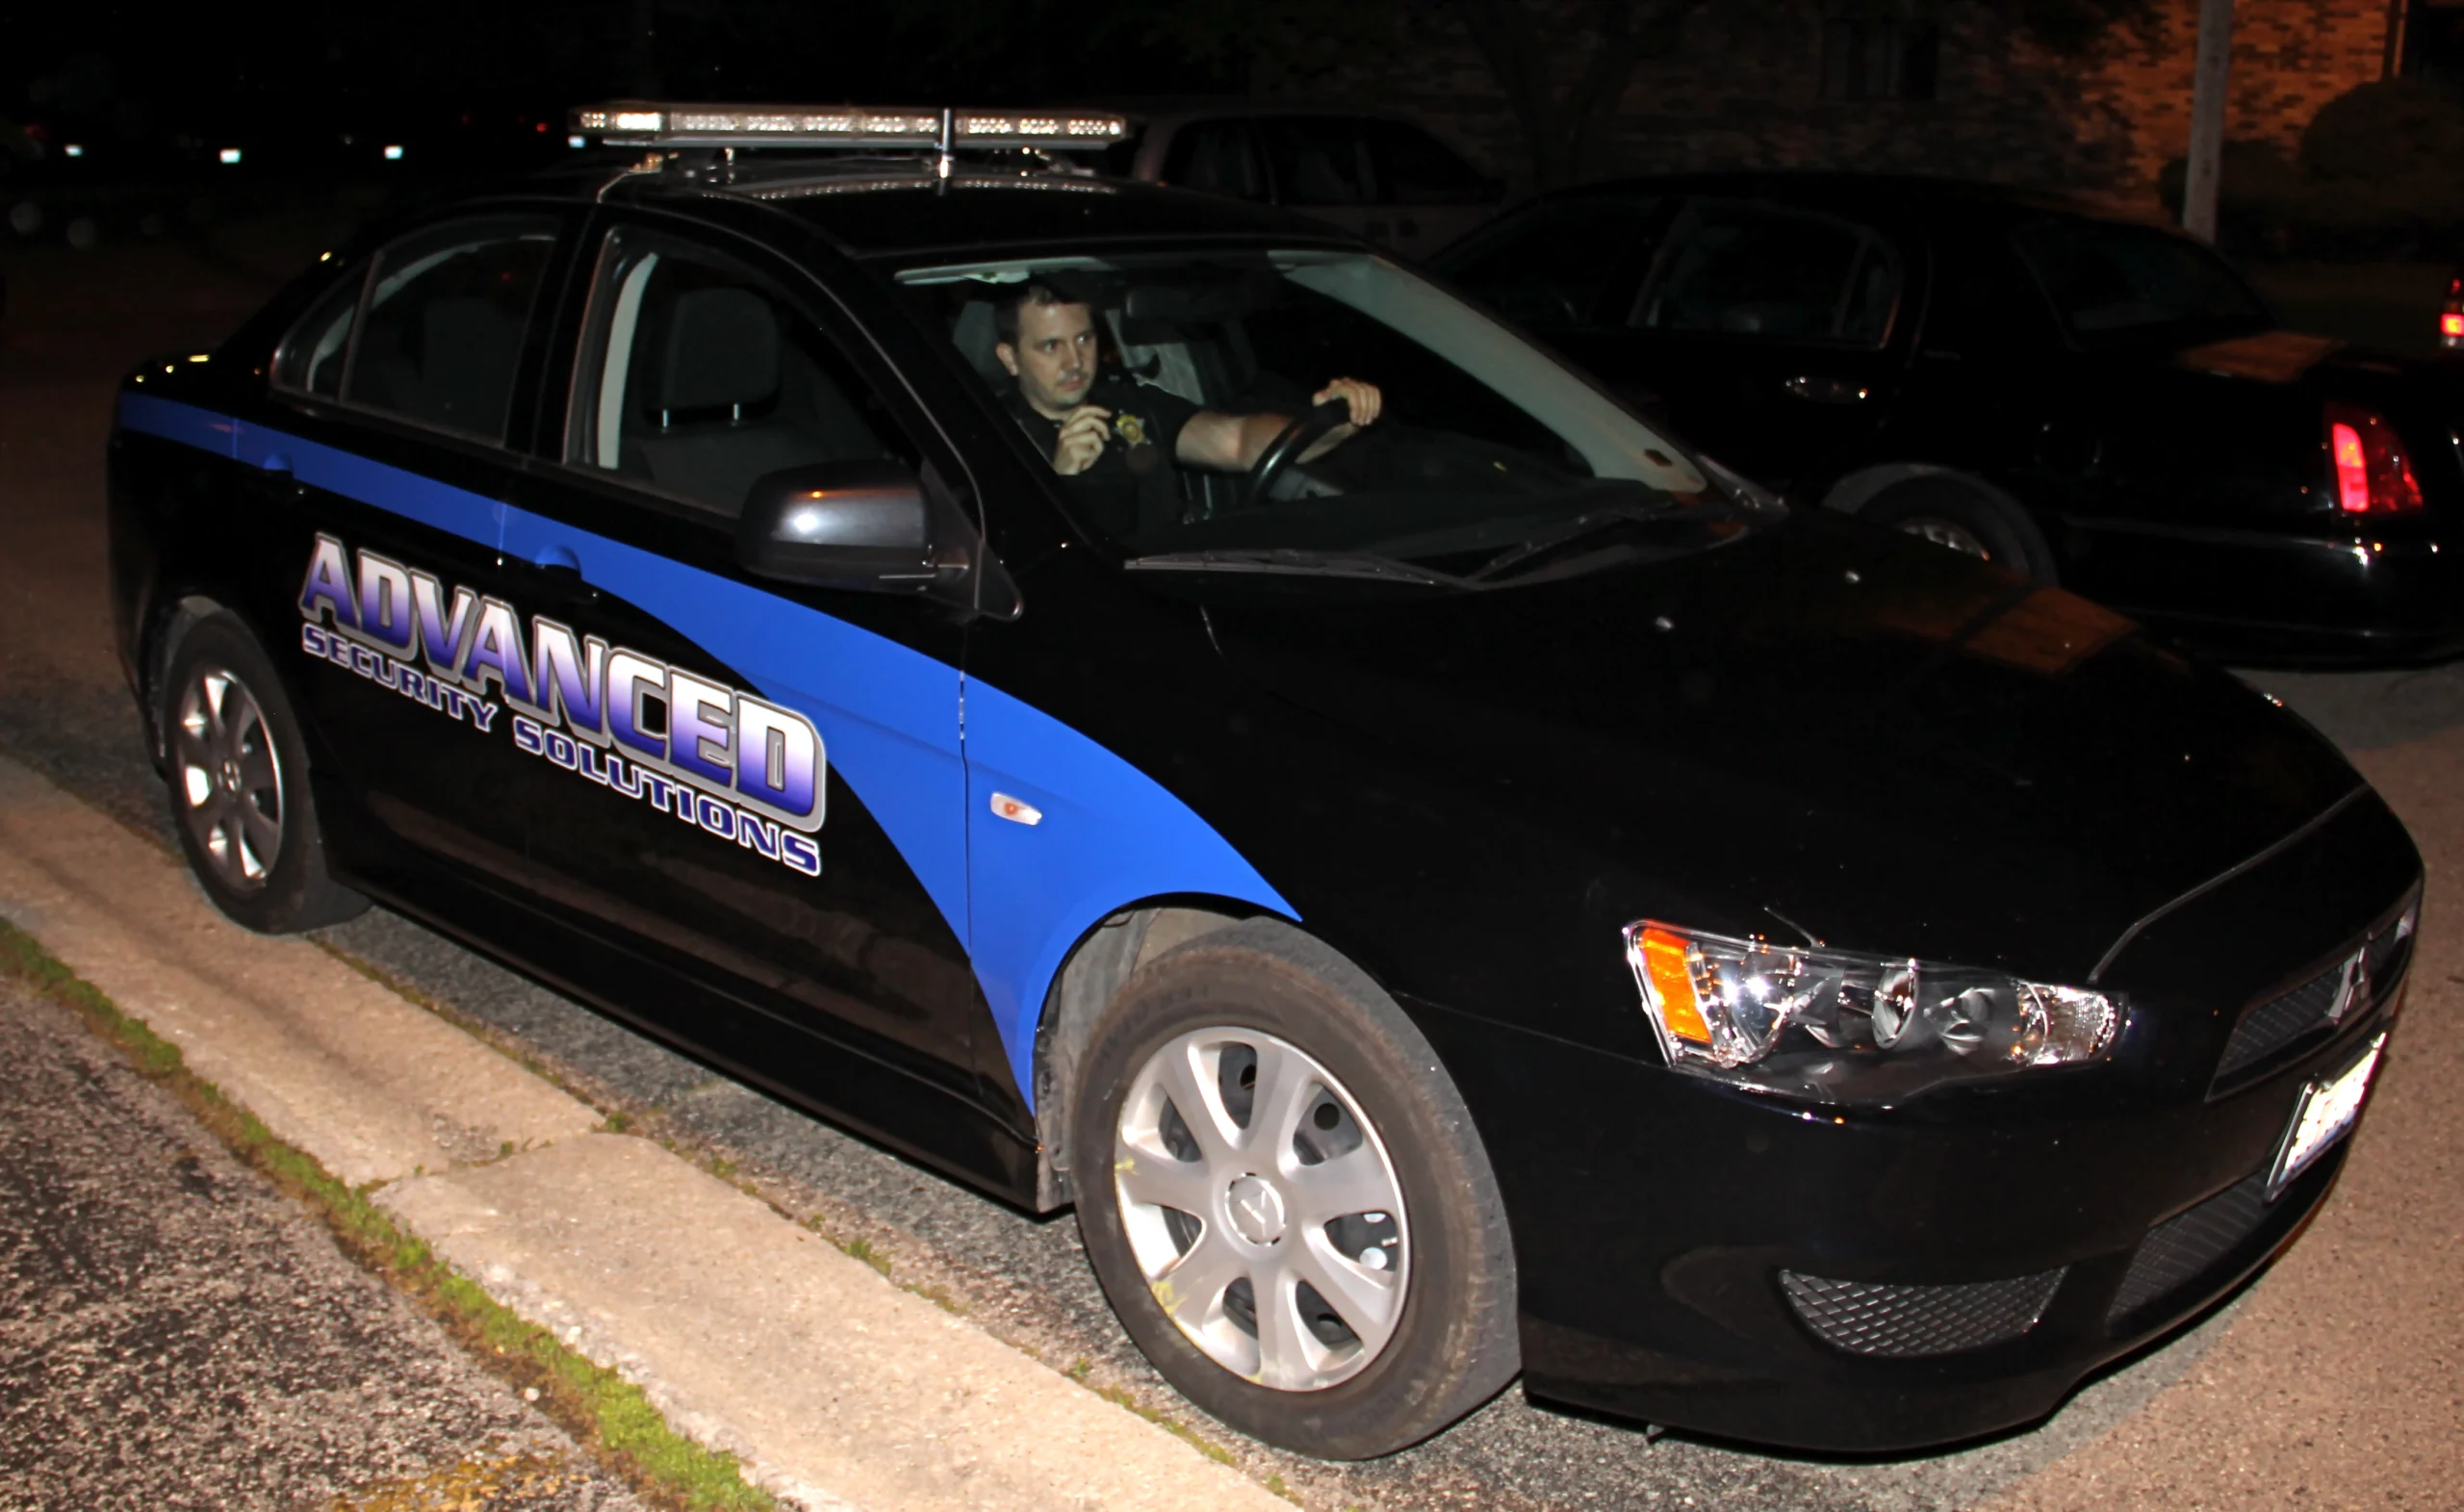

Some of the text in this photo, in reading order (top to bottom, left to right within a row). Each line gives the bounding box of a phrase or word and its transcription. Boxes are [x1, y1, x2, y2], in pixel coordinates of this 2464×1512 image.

[299, 532, 826, 833] ADVANCED
[301, 623, 822, 877] SECURITY SOLUTIONS
